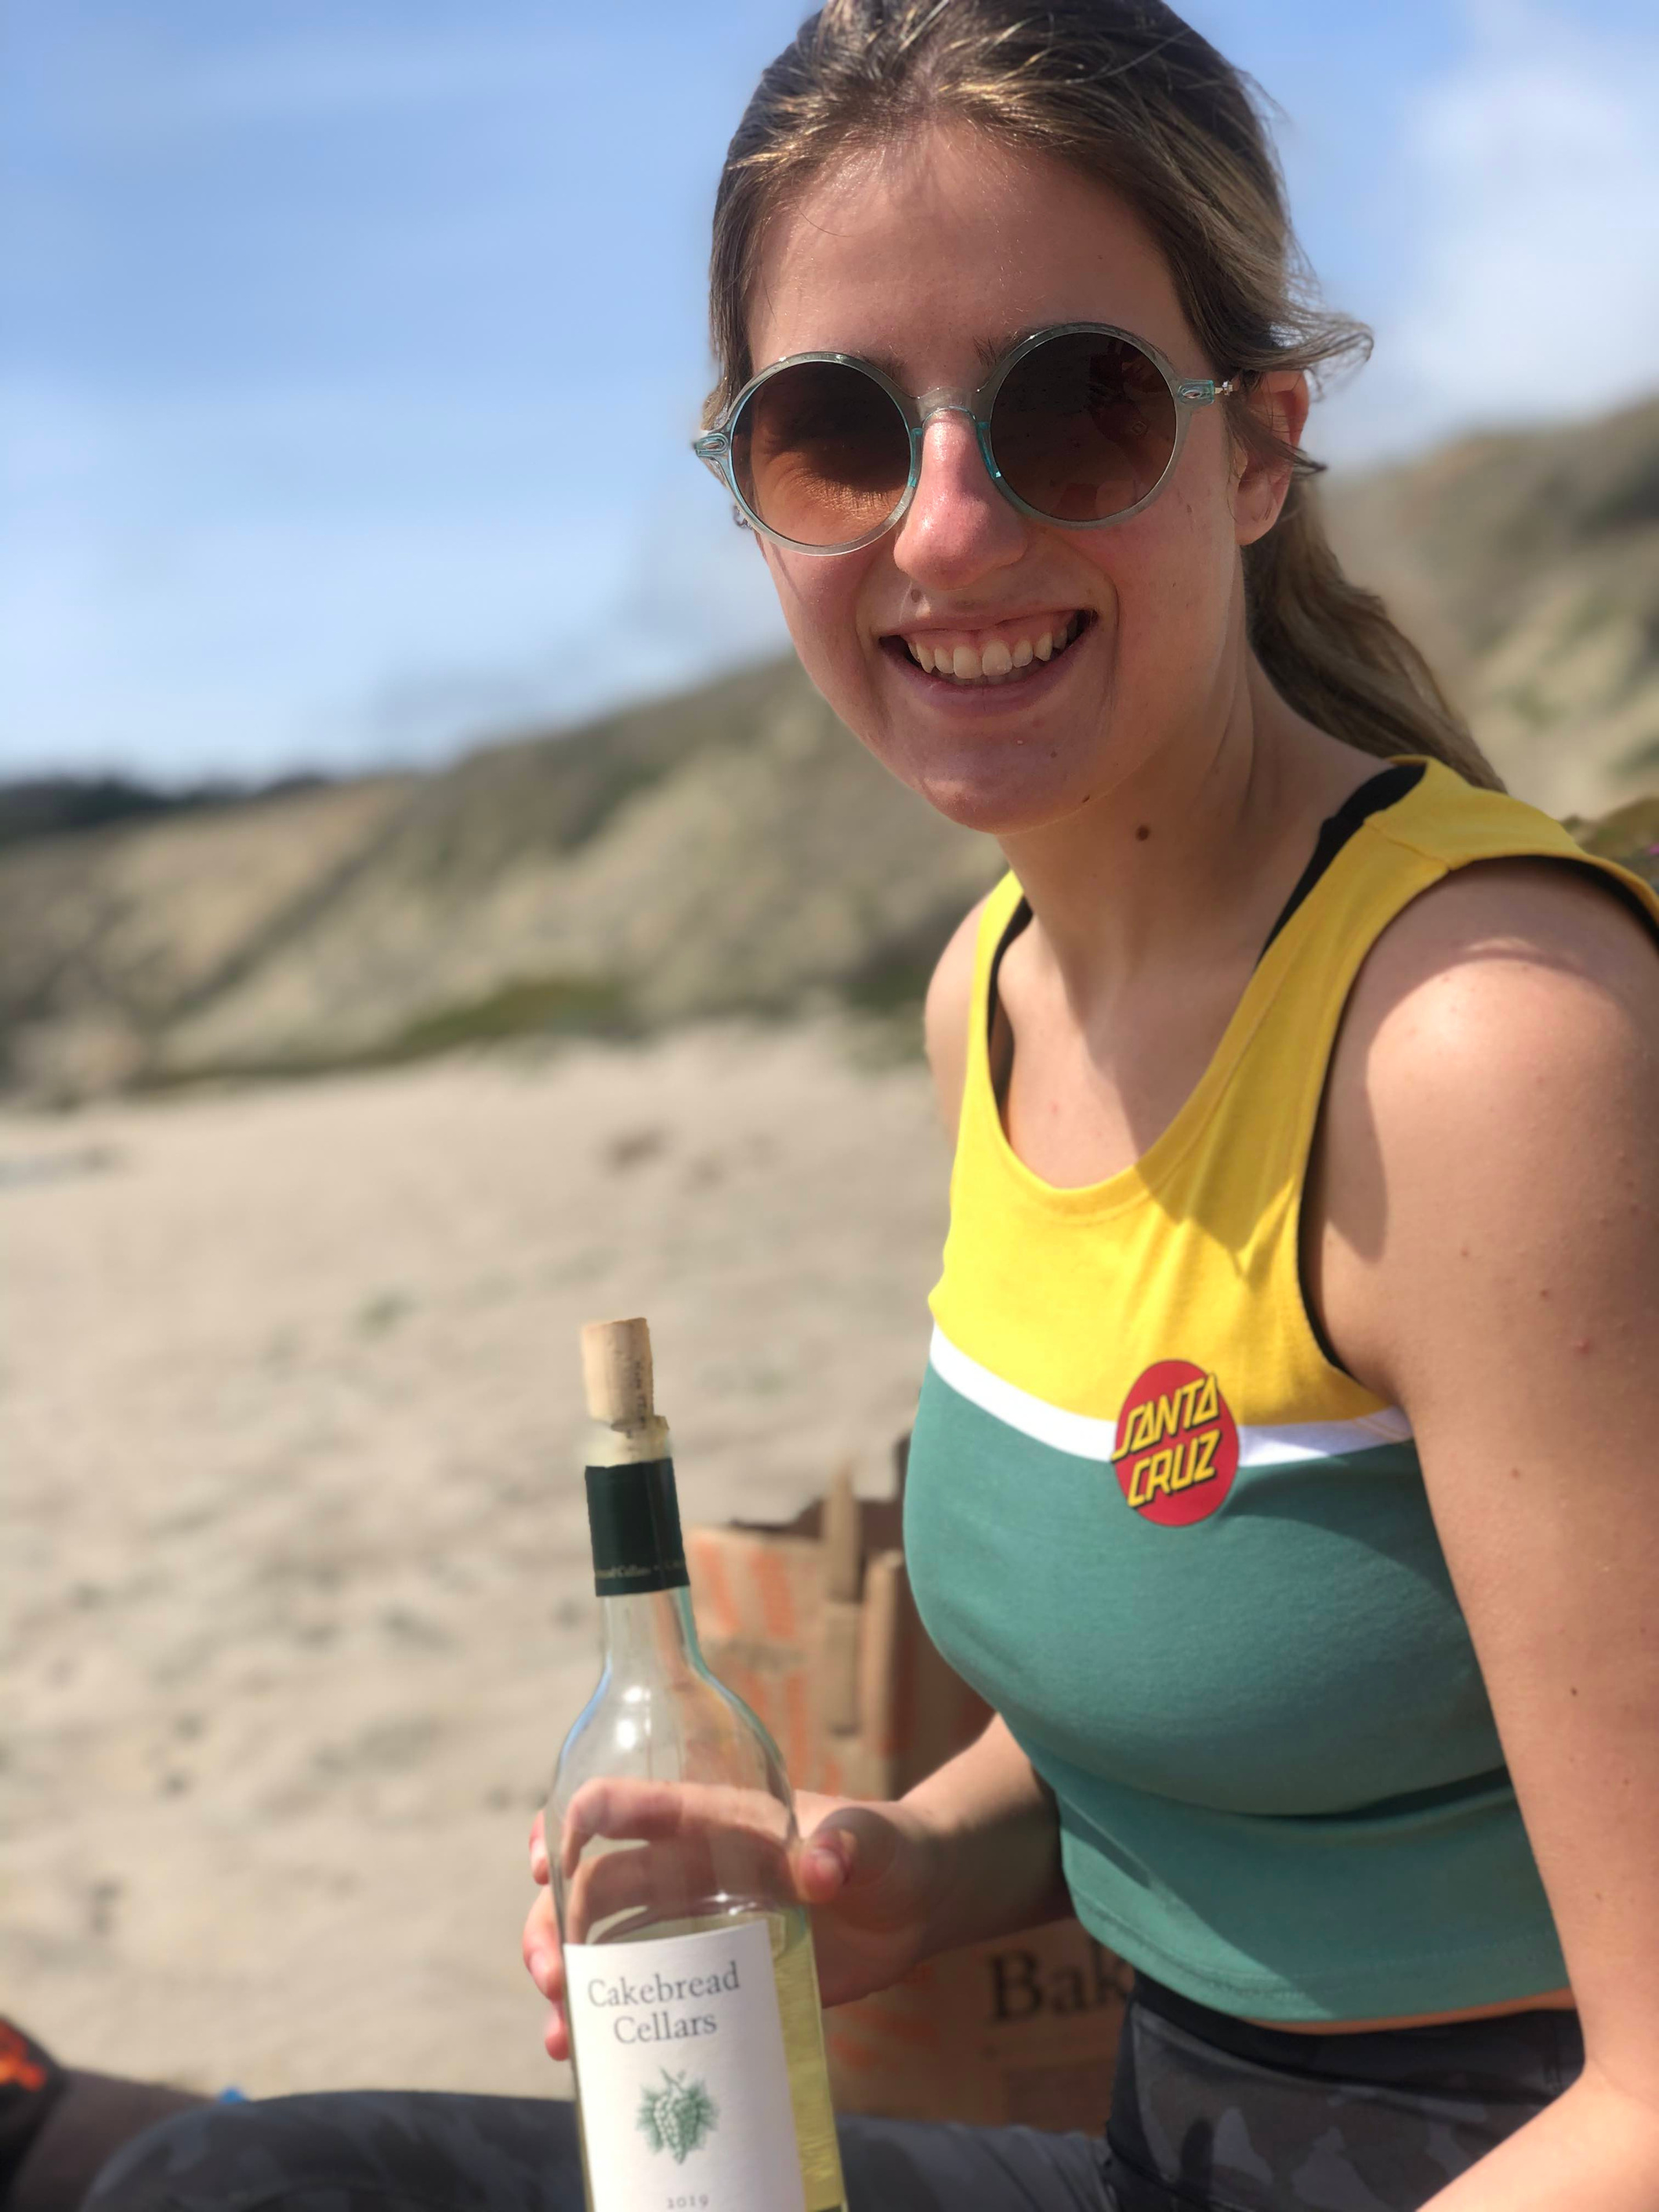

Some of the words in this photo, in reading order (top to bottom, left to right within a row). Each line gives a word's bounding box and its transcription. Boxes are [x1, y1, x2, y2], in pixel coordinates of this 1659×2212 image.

[1110, 1373, 1219, 1463] SANTA
[1127, 1428, 1222, 1509] CRUZ
[588, 1960, 741, 2007] Cakebread
[614, 2011, 718, 2044] Cellars
[666, 2194, 709, 2210] 2019
